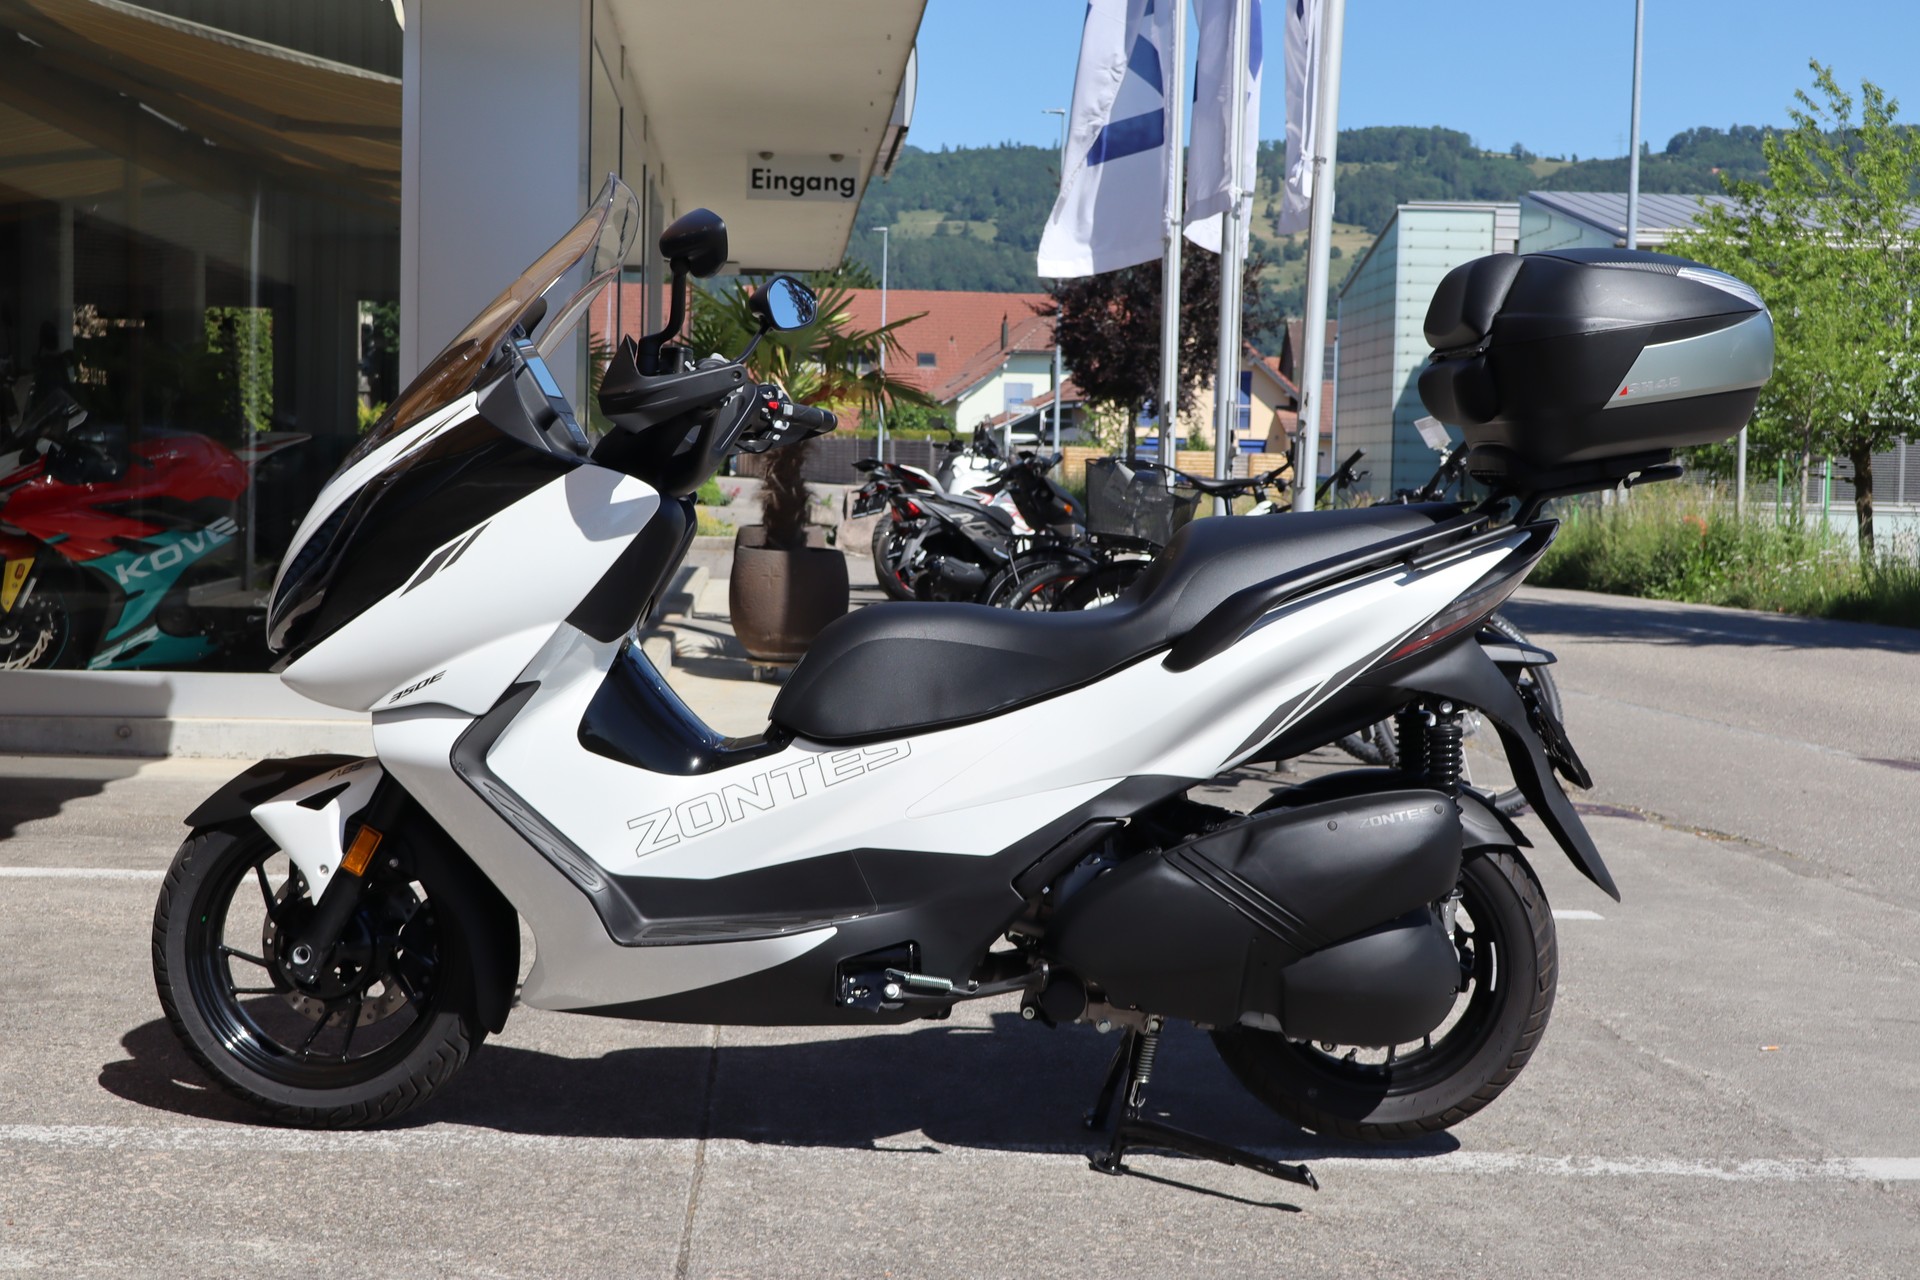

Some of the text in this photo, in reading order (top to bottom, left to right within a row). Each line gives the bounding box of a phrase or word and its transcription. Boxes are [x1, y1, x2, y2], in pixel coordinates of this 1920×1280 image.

[751, 167, 856, 199] Eingang
[115, 516, 239, 585] KOVE
[388, 669, 448, 704] 350E
[627, 740, 912, 858] ZONTES
[1359, 806, 1431, 829] ZONTES
